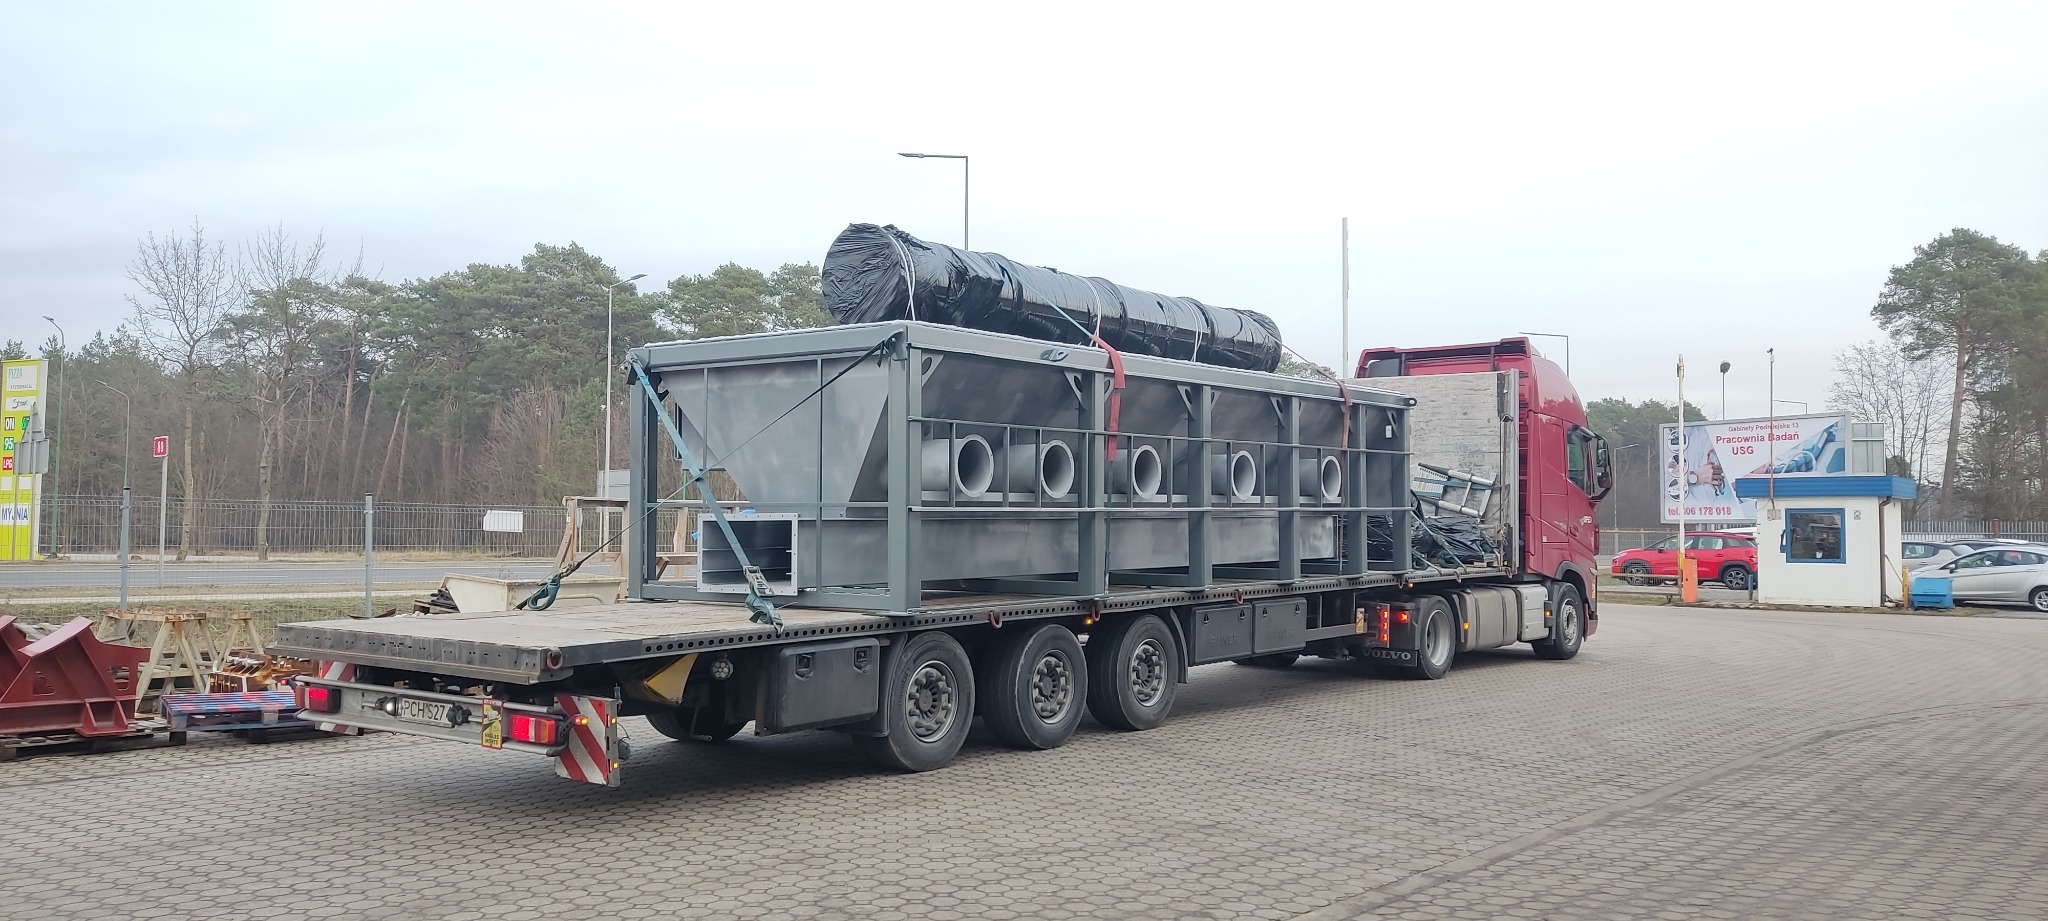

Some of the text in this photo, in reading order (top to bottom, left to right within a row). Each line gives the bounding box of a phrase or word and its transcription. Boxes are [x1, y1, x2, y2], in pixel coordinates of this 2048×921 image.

[6, 418, 15, 430] ON
[1715, 431, 1799, 444] Pracownia Badań
[5, 438, 14, 450] 95
[1732, 446, 1754, 455] USG
[3, 458, 13, 469] LPG
[1668, 506, 1732, 516] tel. 06 178 018
[1363, 649, 1412, 660] VOLVO
